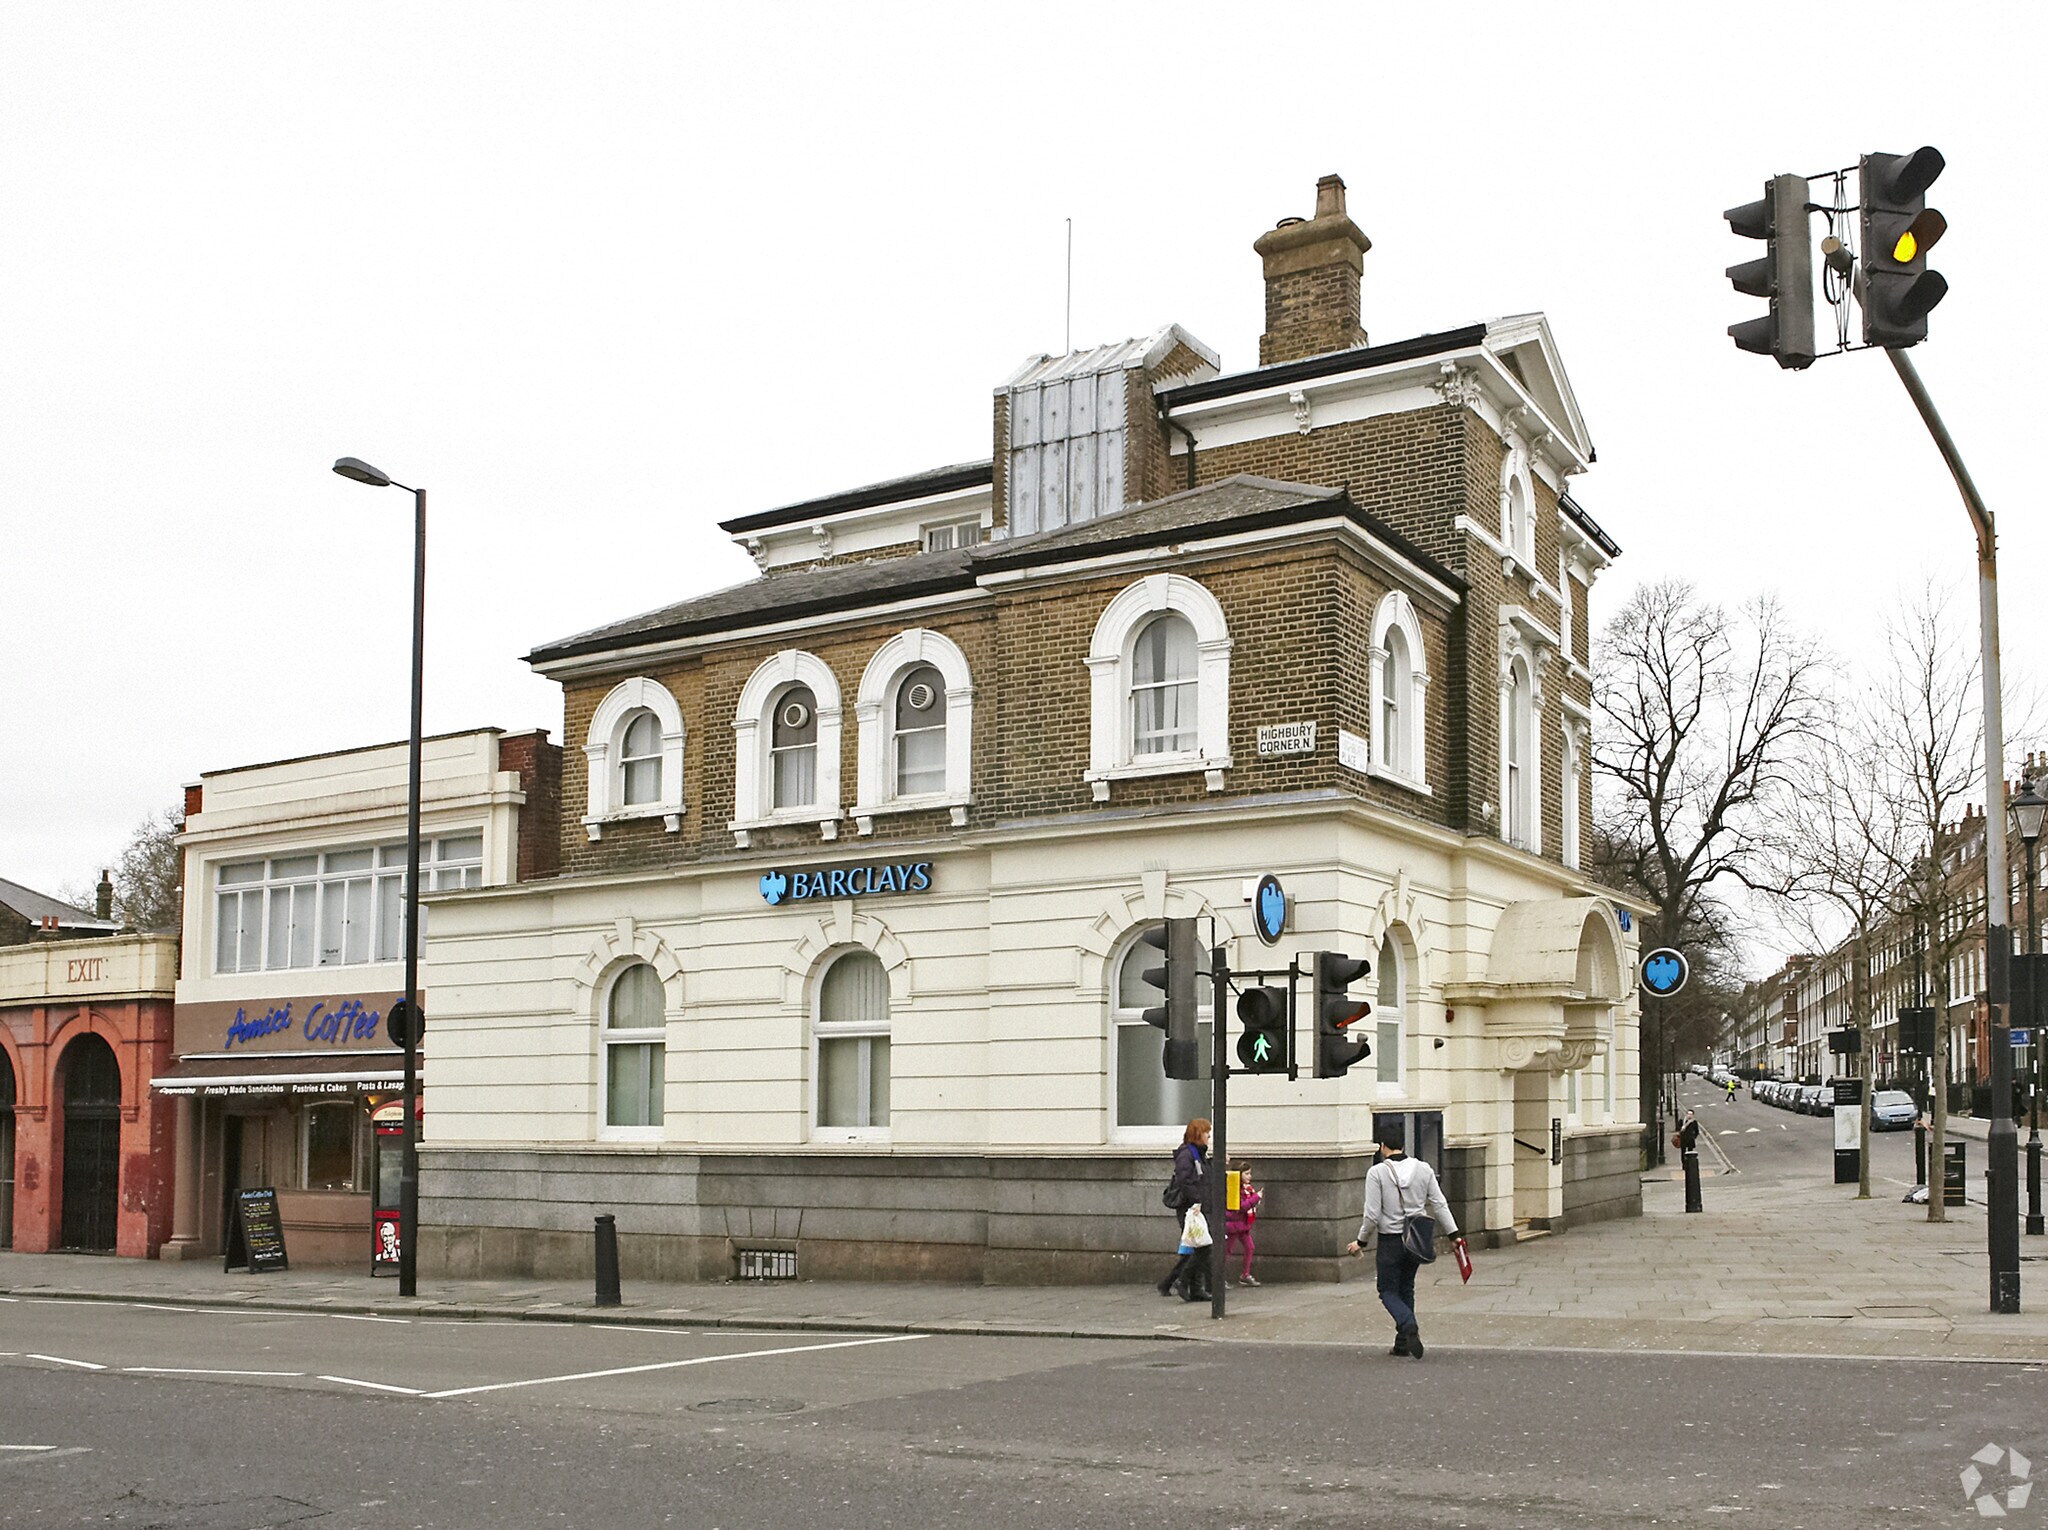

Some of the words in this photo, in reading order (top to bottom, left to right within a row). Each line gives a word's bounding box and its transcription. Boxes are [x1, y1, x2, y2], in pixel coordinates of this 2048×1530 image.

[1260, 725, 1313, 741] HIGHBURY
[1259, 740, 1300, 753] CORNER
[792, 862, 933, 900] BARCLAYS
[67, 957, 103, 983] EXIT
[225, 1002, 293, 1049] Amici
[303, 999, 380, 1043] Coffee
[204, 1087, 228, 1095] Freshly
[230, 1086, 246, 1094] Made
[247, 1084, 284, 1093] Sandwiches
[292, 1084, 318, 1093] Pastries
[319, 1083, 325, 1092] &
[326, 1083, 348, 1092] Cakes
[357, 1081, 376, 1091] Pasta
[377, 1081, 382, 1091] &
[383, 1081, 405, 1091] Lasag
